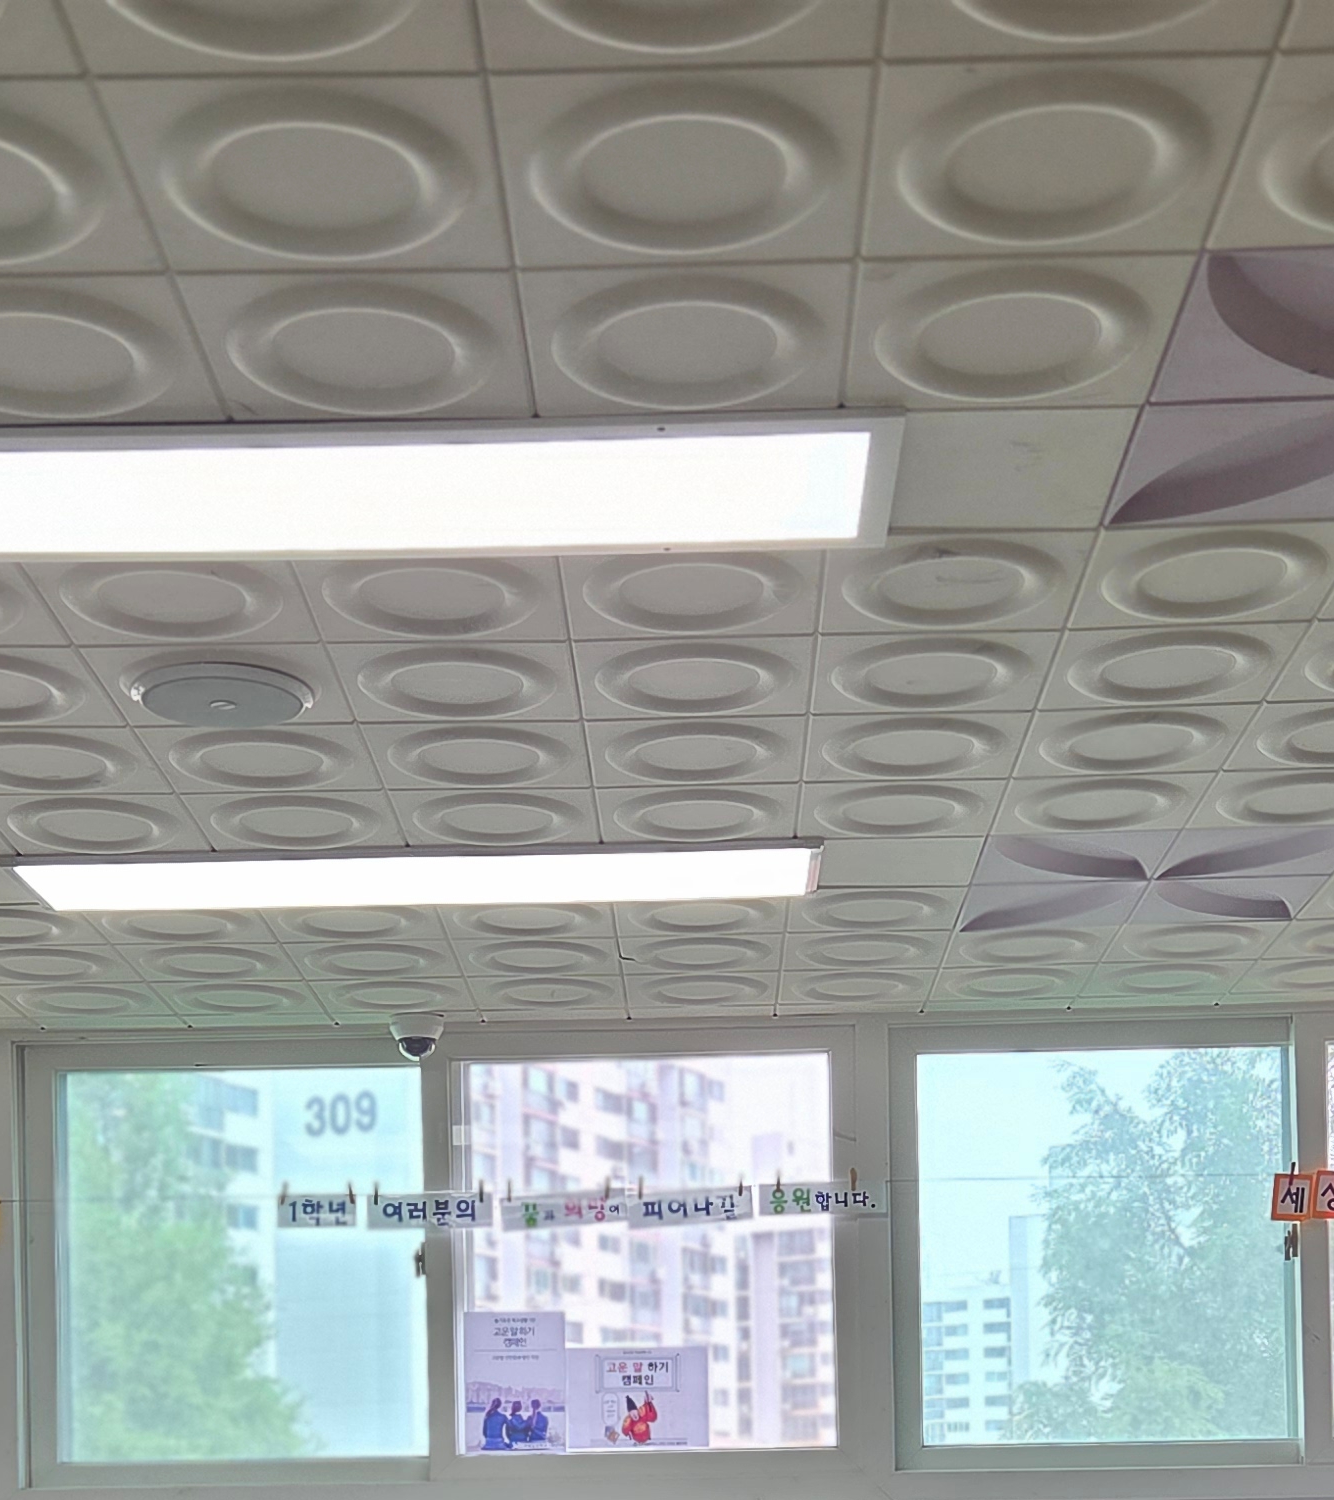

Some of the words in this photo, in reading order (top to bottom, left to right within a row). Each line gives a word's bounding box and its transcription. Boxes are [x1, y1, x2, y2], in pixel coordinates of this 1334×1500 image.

[305, 1090, 378, 1137] 309
[288, 1199, 347, 1226] 1학년
[382, 1199, 476, 1226] 여러분의
[642, 1193, 736, 1221] 피어나길
[769, 1186, 876, 1214] 응원합니다.
[606, 1361, 628, 1373] 고운
[632, 1361, 643, 1373] 말
[647, 1361, 669, 1373] 하기
[621, 1374, 655, 1386] 캠페인
